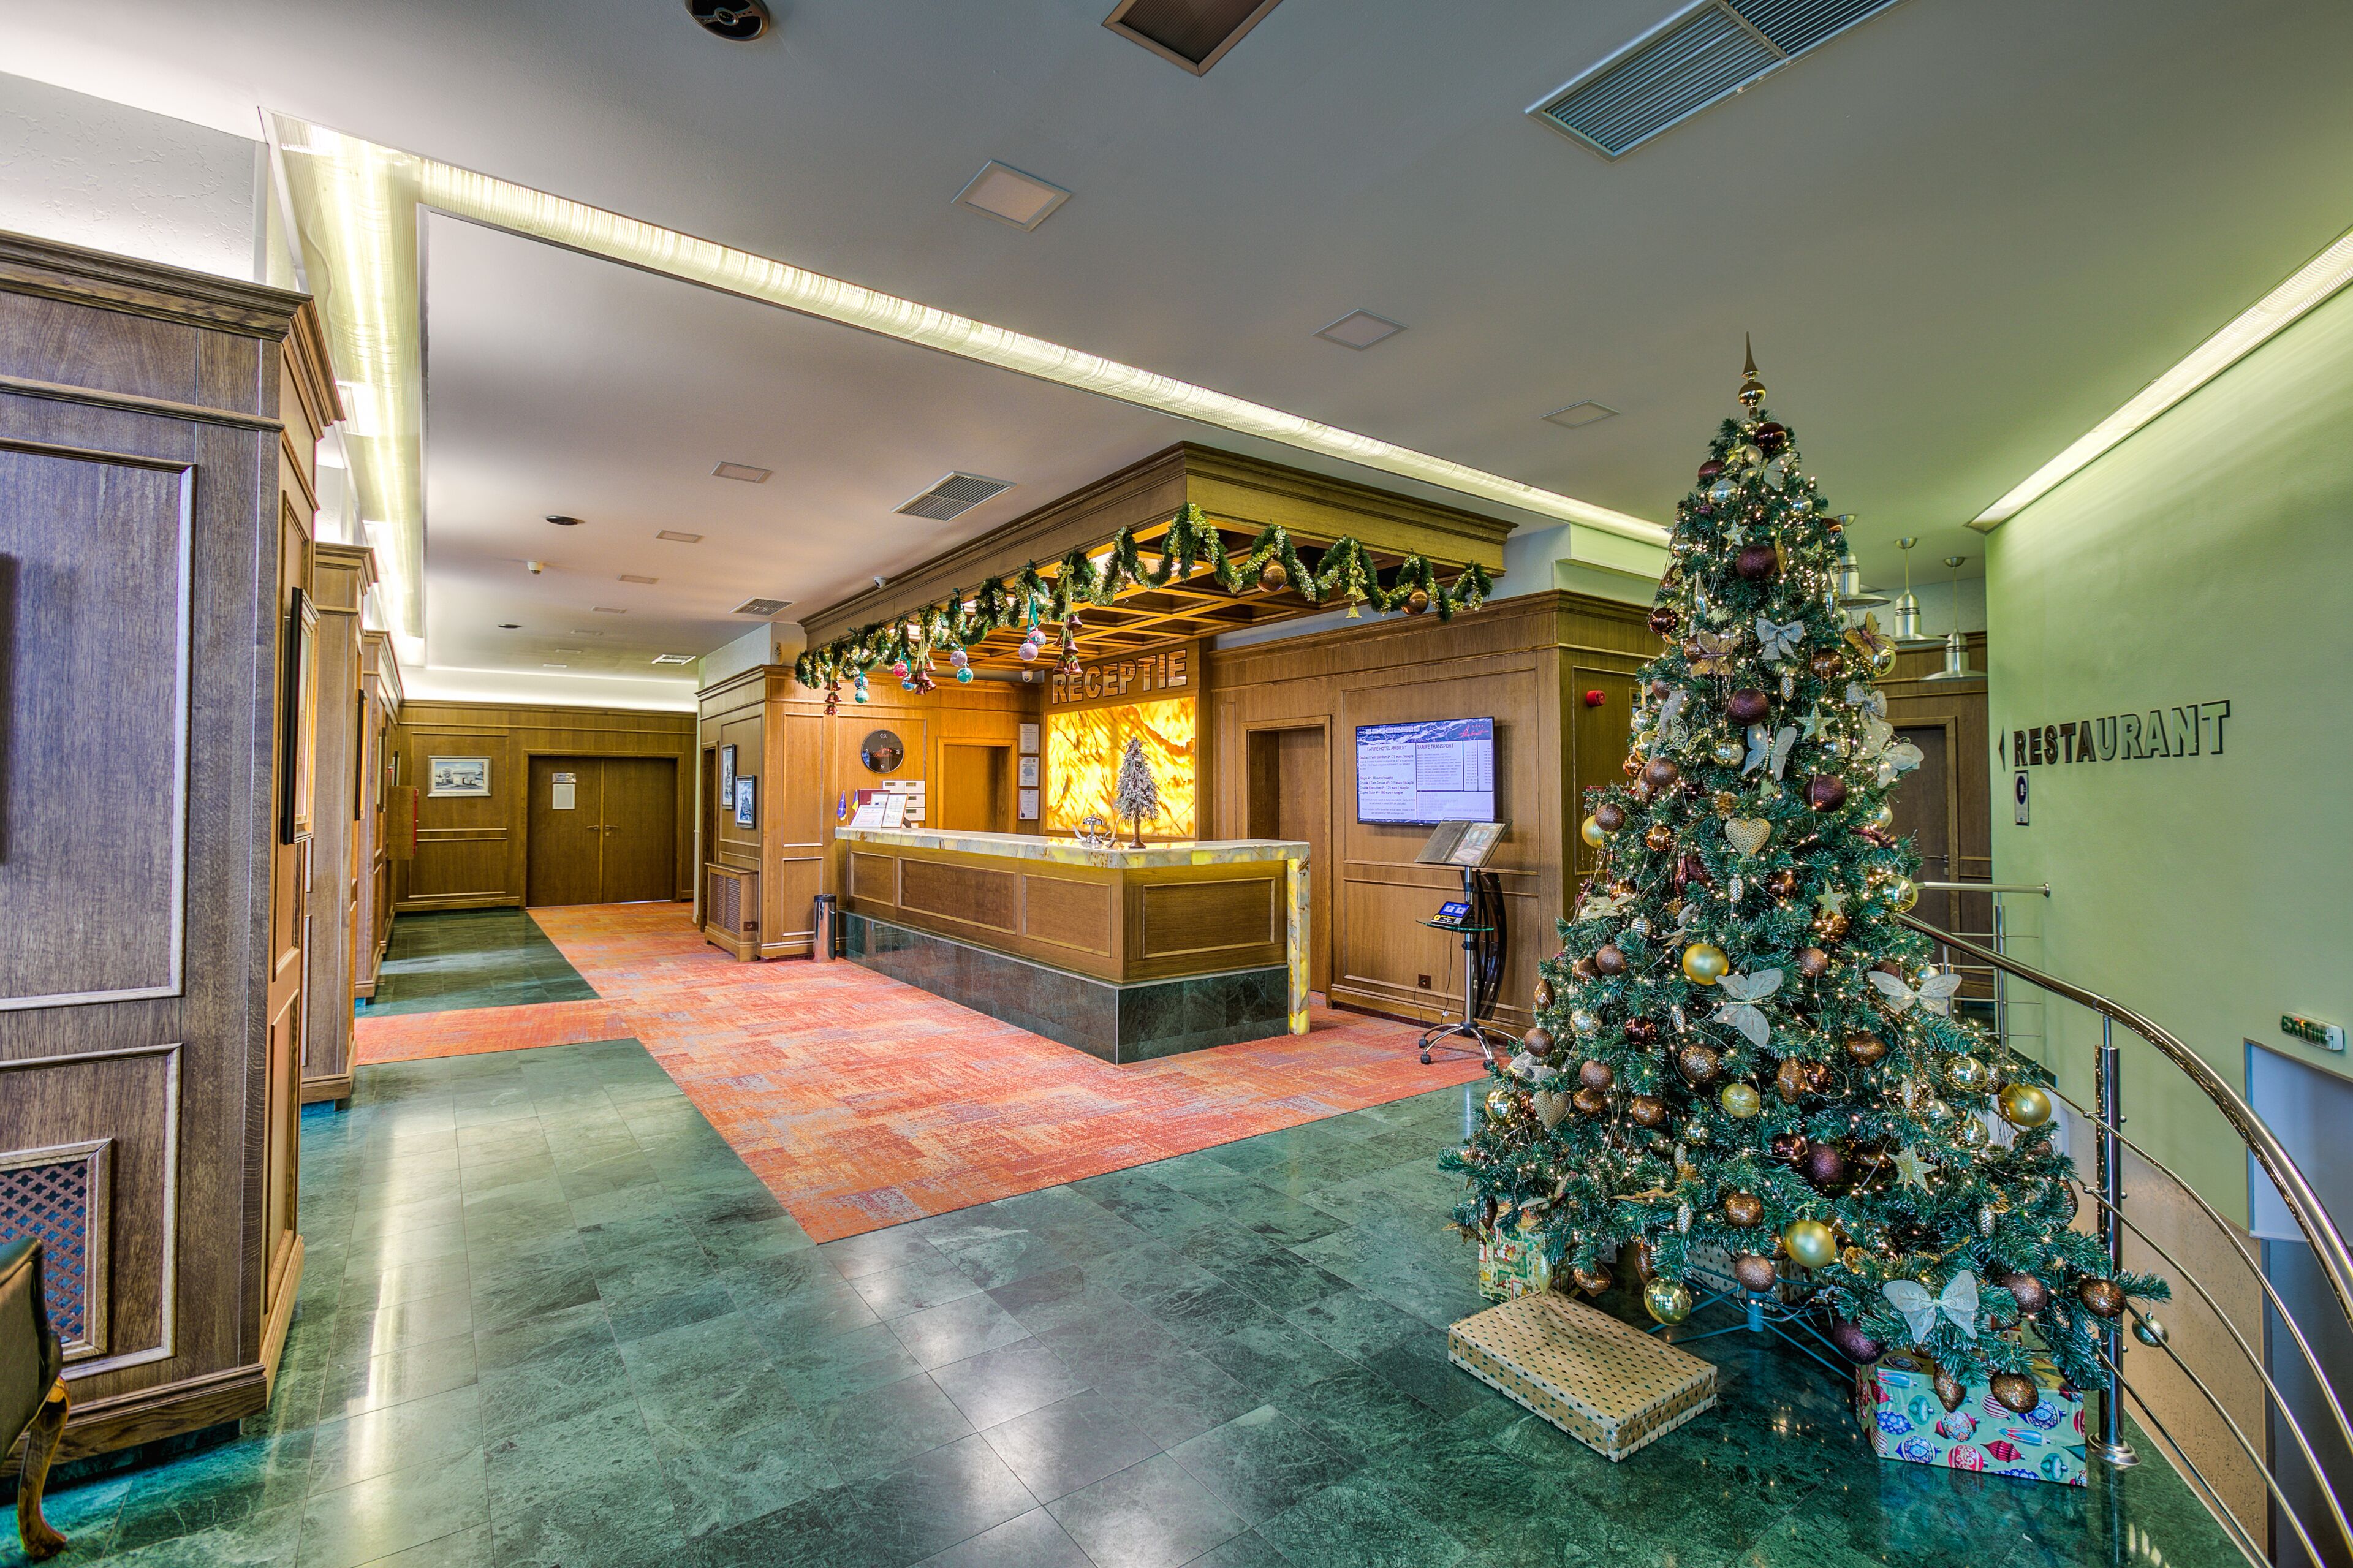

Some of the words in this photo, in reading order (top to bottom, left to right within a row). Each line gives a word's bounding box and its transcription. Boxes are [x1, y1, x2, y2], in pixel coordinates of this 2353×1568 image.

[1052, 648, 1188, 705] RECEPTIE
[2013, 699, 2230, 766] RESTAURANT
[2281, 1015, 2312, 1040] EXIT
